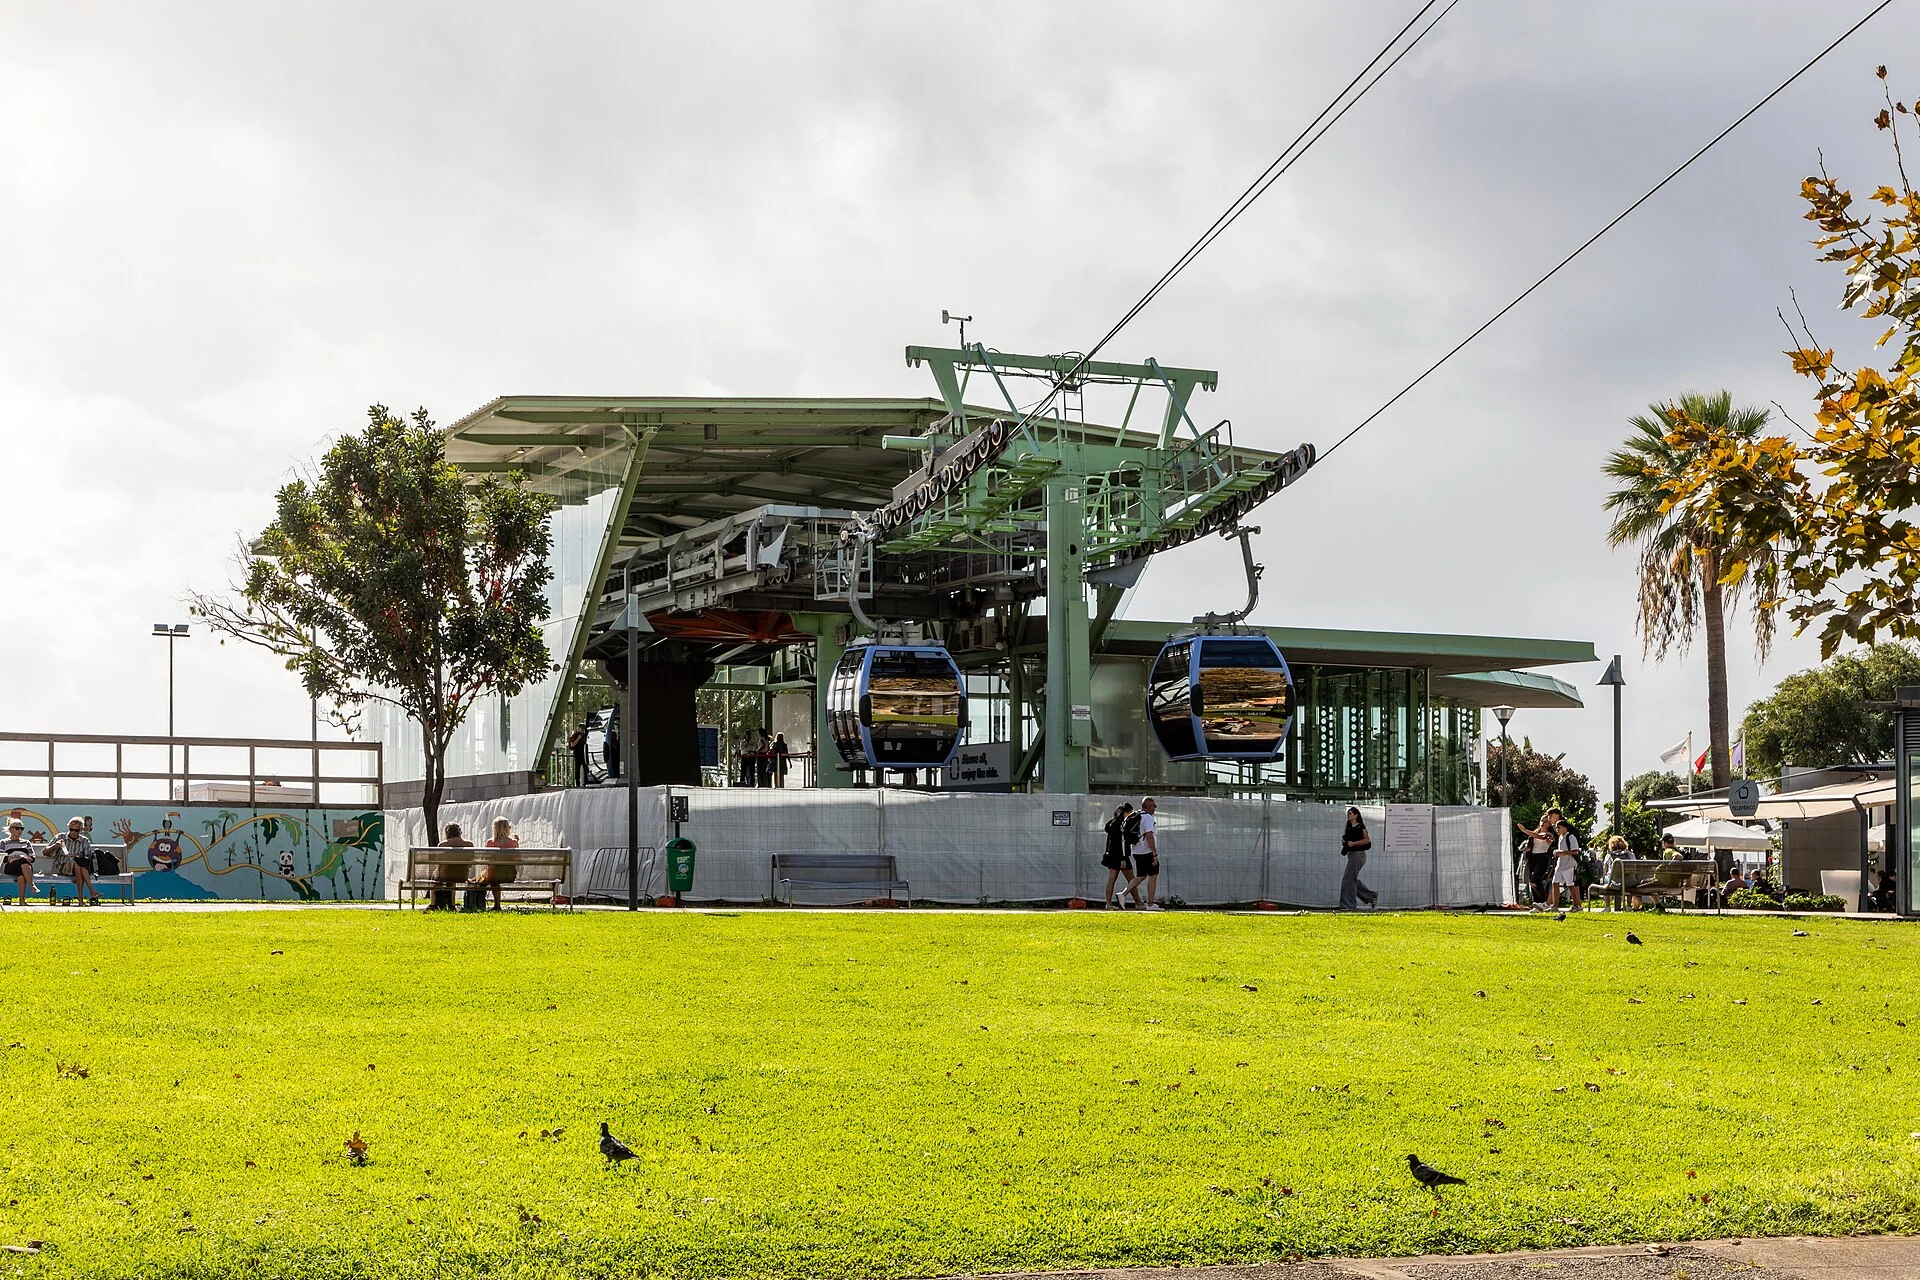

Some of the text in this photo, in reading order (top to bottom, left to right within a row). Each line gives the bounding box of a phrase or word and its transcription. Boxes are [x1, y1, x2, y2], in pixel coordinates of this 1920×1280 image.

[962, 753, 978, 764] Above
[961, 768, 976, 781] enjoy
[977, 767, 985, 778] the
